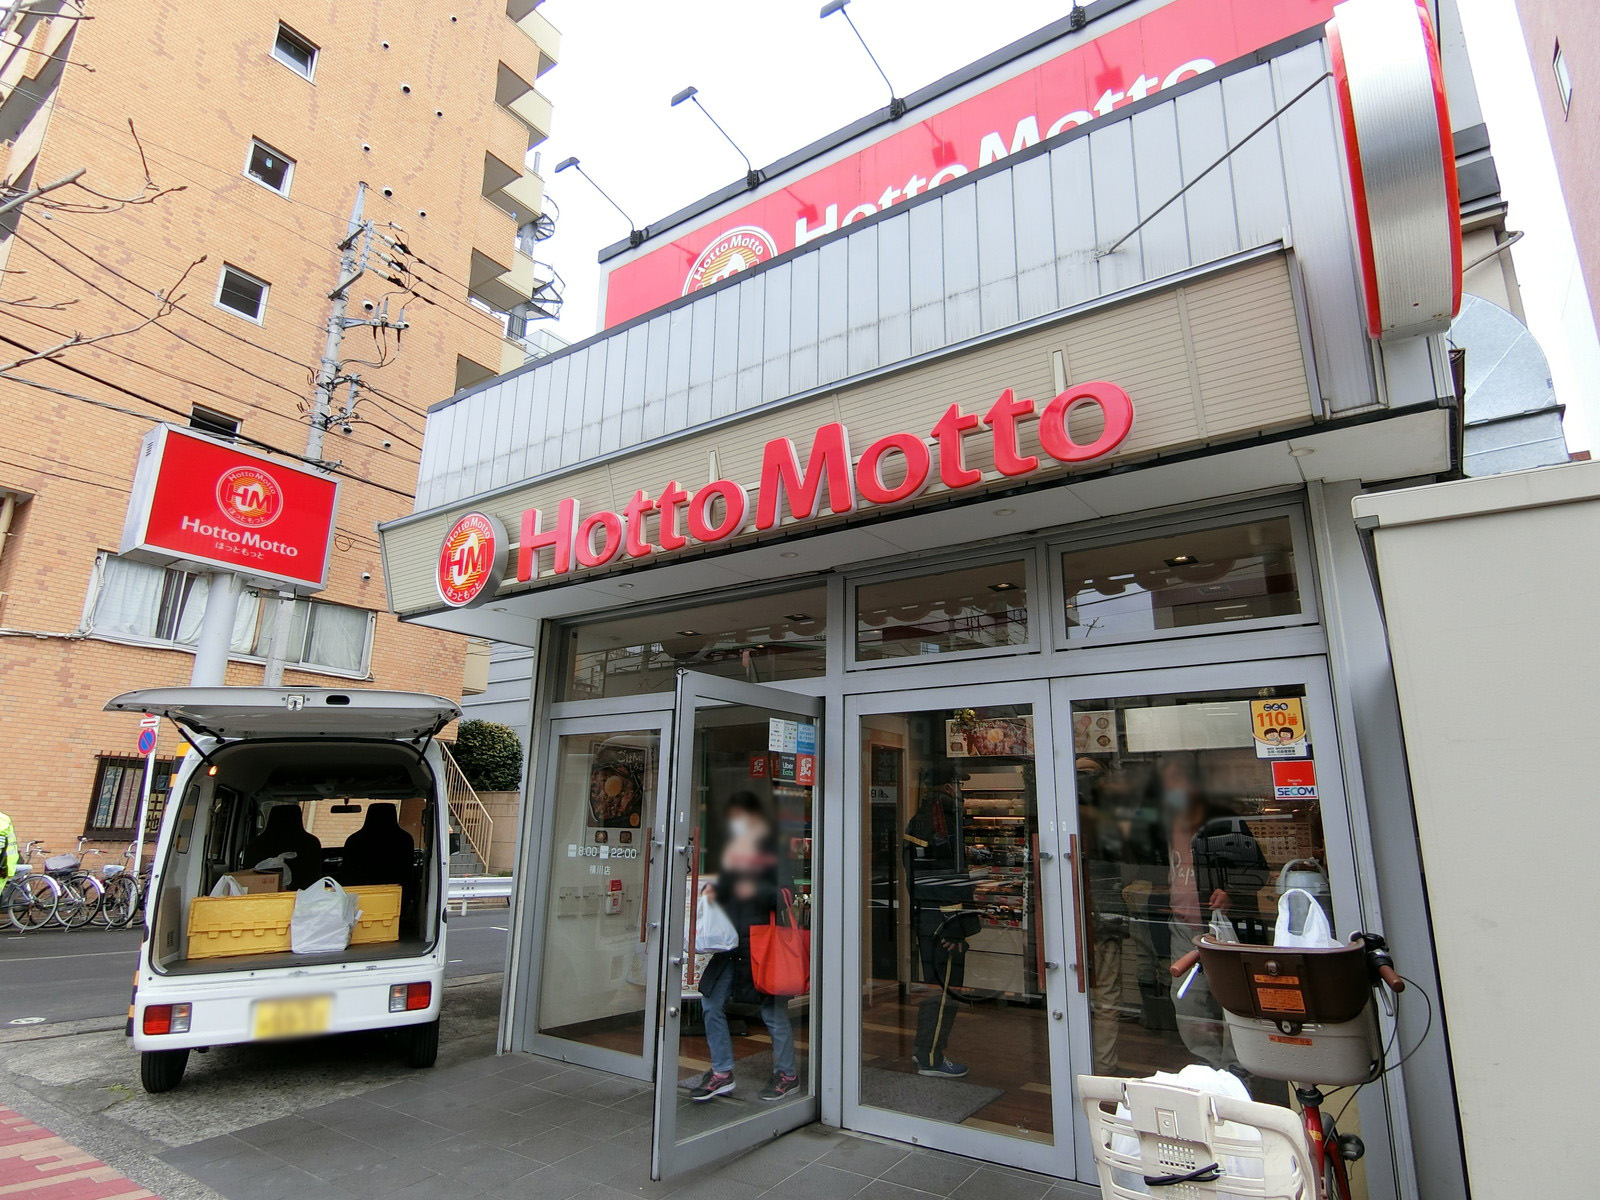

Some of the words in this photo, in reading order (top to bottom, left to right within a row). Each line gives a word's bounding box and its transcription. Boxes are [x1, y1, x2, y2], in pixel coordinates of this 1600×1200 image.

[215, 542, 265, 560] ほっともっと
[1277, 786, 1315, 796] SECOM
[578, 846, 597, 857] 8:00
[610, 847, 637, 859] 22:00
